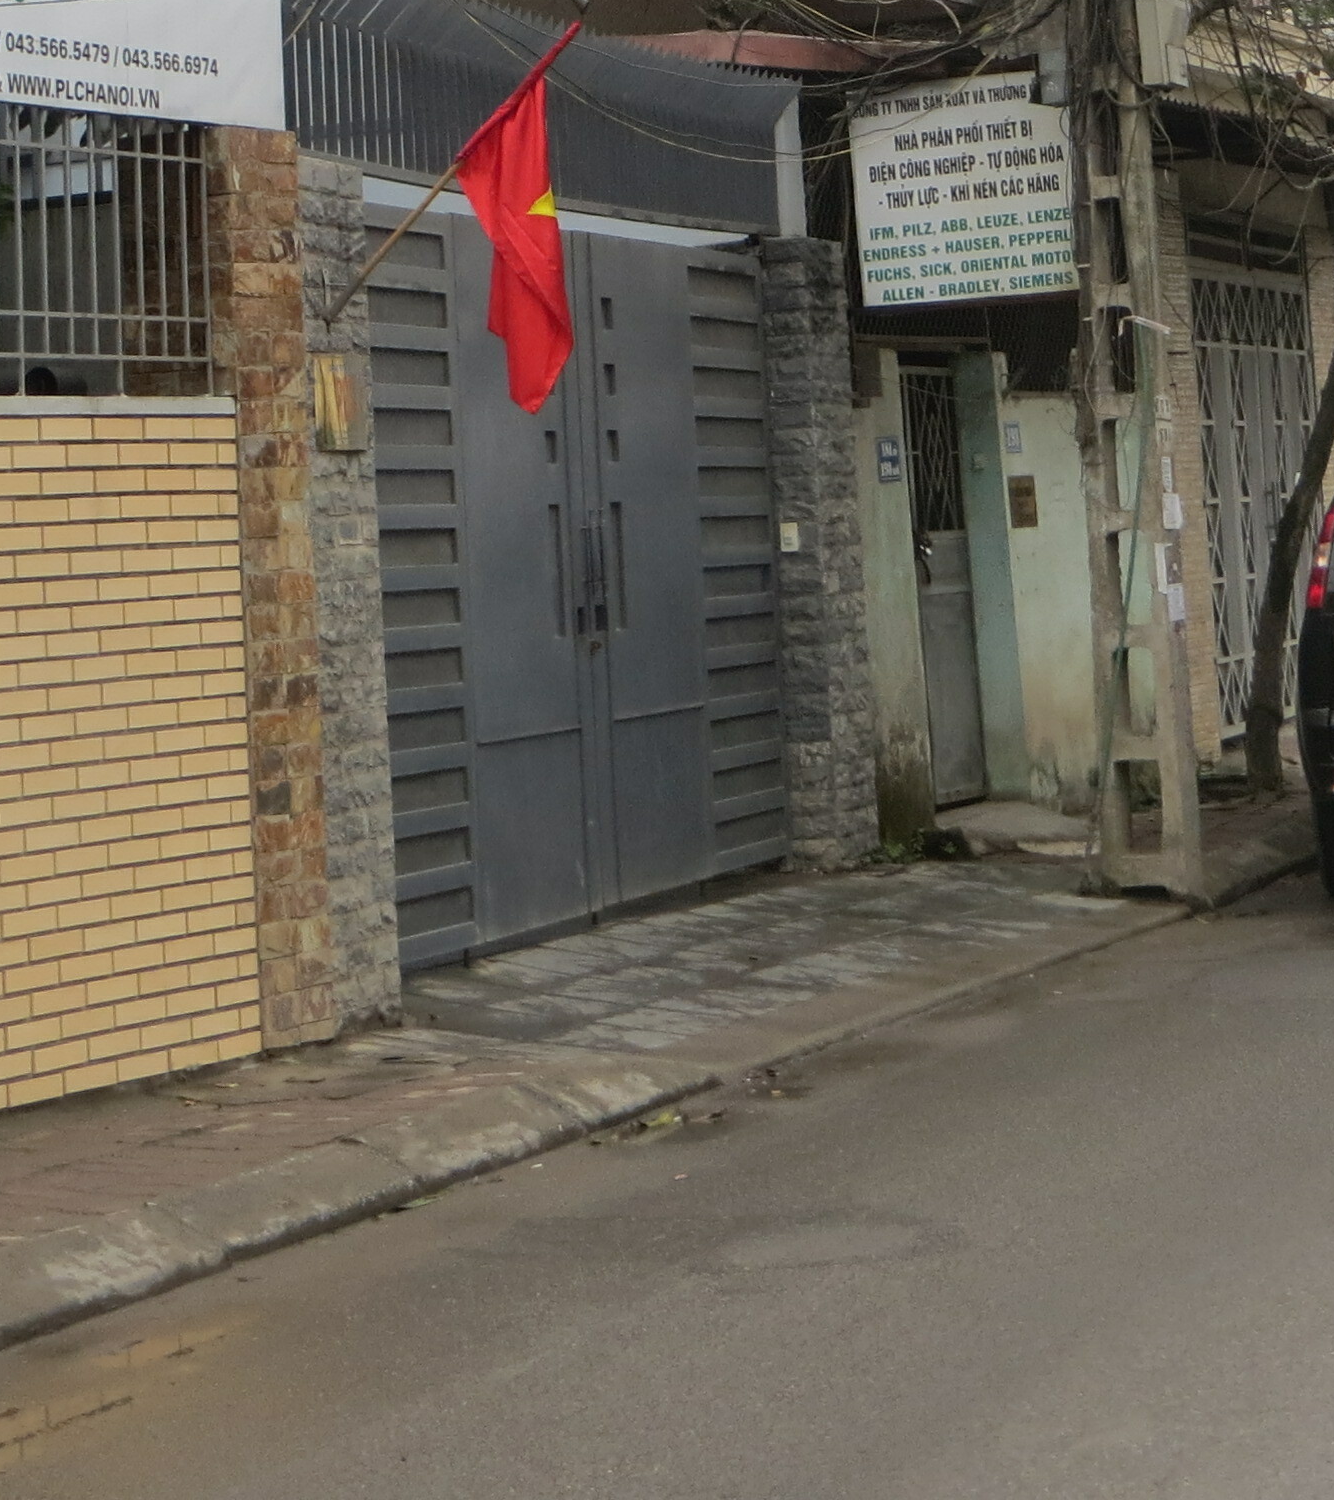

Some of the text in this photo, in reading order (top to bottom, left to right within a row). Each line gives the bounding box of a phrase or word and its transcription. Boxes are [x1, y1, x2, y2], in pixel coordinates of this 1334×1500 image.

[4, 31, 110, 65] 043.566.5479
[122, 48, 219, 77] 043.566.6974
[7, 72, 161, 110] WWW.PLCHANOI.VN
[881, 102, 893, 116] TY
[895, 97, 921, 115] TNHH
[972, 86, 987, 104] VÀ
[894, 115, 1034, 152] NHÀ PHÂN PHỐI THIẾT BỊ
[868, 161, 897, 186] ĐIỆN
[899, 156, 932, 181] CÔNG
[933, 151, 977, 178] NGHIỆP
[987, 150, 1004, 174] TỰ
[1005, 147, 1037, 172] ĐỘNG
[1040, 141, 1065, 164] HÓA
[885, 183, 916, 210] THỦY
[917, 185, 940, 209] LỰC
[973, 179, 999, 200] NÉN
[1000, 175, 1025, 197] CÁC
[1027, 173, 1061, 193] HÃNG
[869, 225, 899, 241] IFM,
[902, 221, 937, 238] PILZ,
[940, 217, 973, 233] ABB,
[976, 212, 1024, 230] LEUZE,
[863, 228, 1072, 262] ENDRESS + HAUSER, PEPPERL
[867, 266, 916, 283] FUCHS,
[919, 261, 957, 279] SICK,
[960, 254, 1028, 274] ORIENTAL
[882, 286, 925, 303] ALLEN
[938, 278, 1006, 298] BRADLEY,
[1009, 271, 1073, 290] SIEMENS
